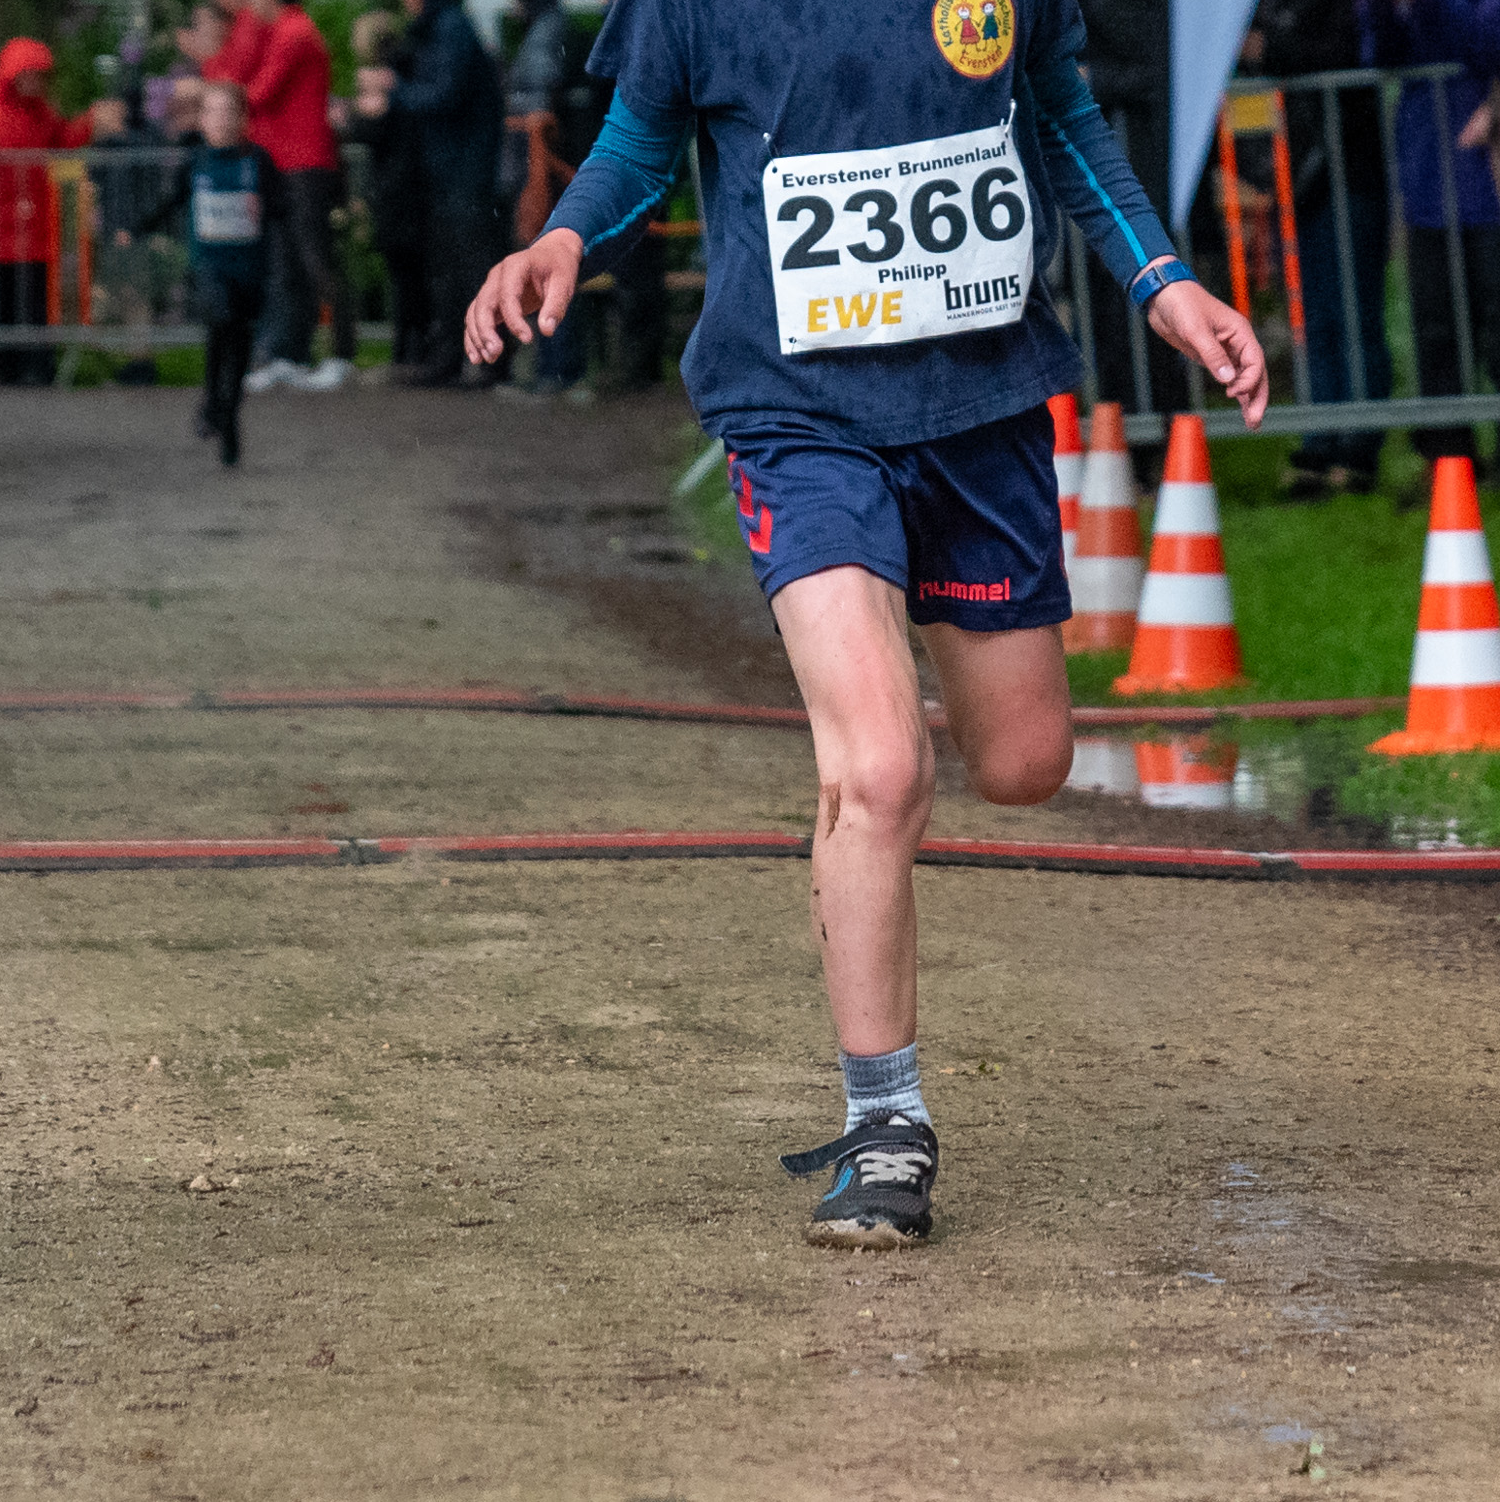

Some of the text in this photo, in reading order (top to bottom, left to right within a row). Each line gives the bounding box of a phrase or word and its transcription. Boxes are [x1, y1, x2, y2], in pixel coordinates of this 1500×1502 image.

[959, 45, 1003, 69] Eversten
[781, 141, 1008, 188] Everstener Brunnenlauf
[776, 166, 1026, 271] 2366
[877, 263, 947, 283] Philipp
[943, 274, 1021, 311] bruns
[807, 290, 903, 333] EWE
